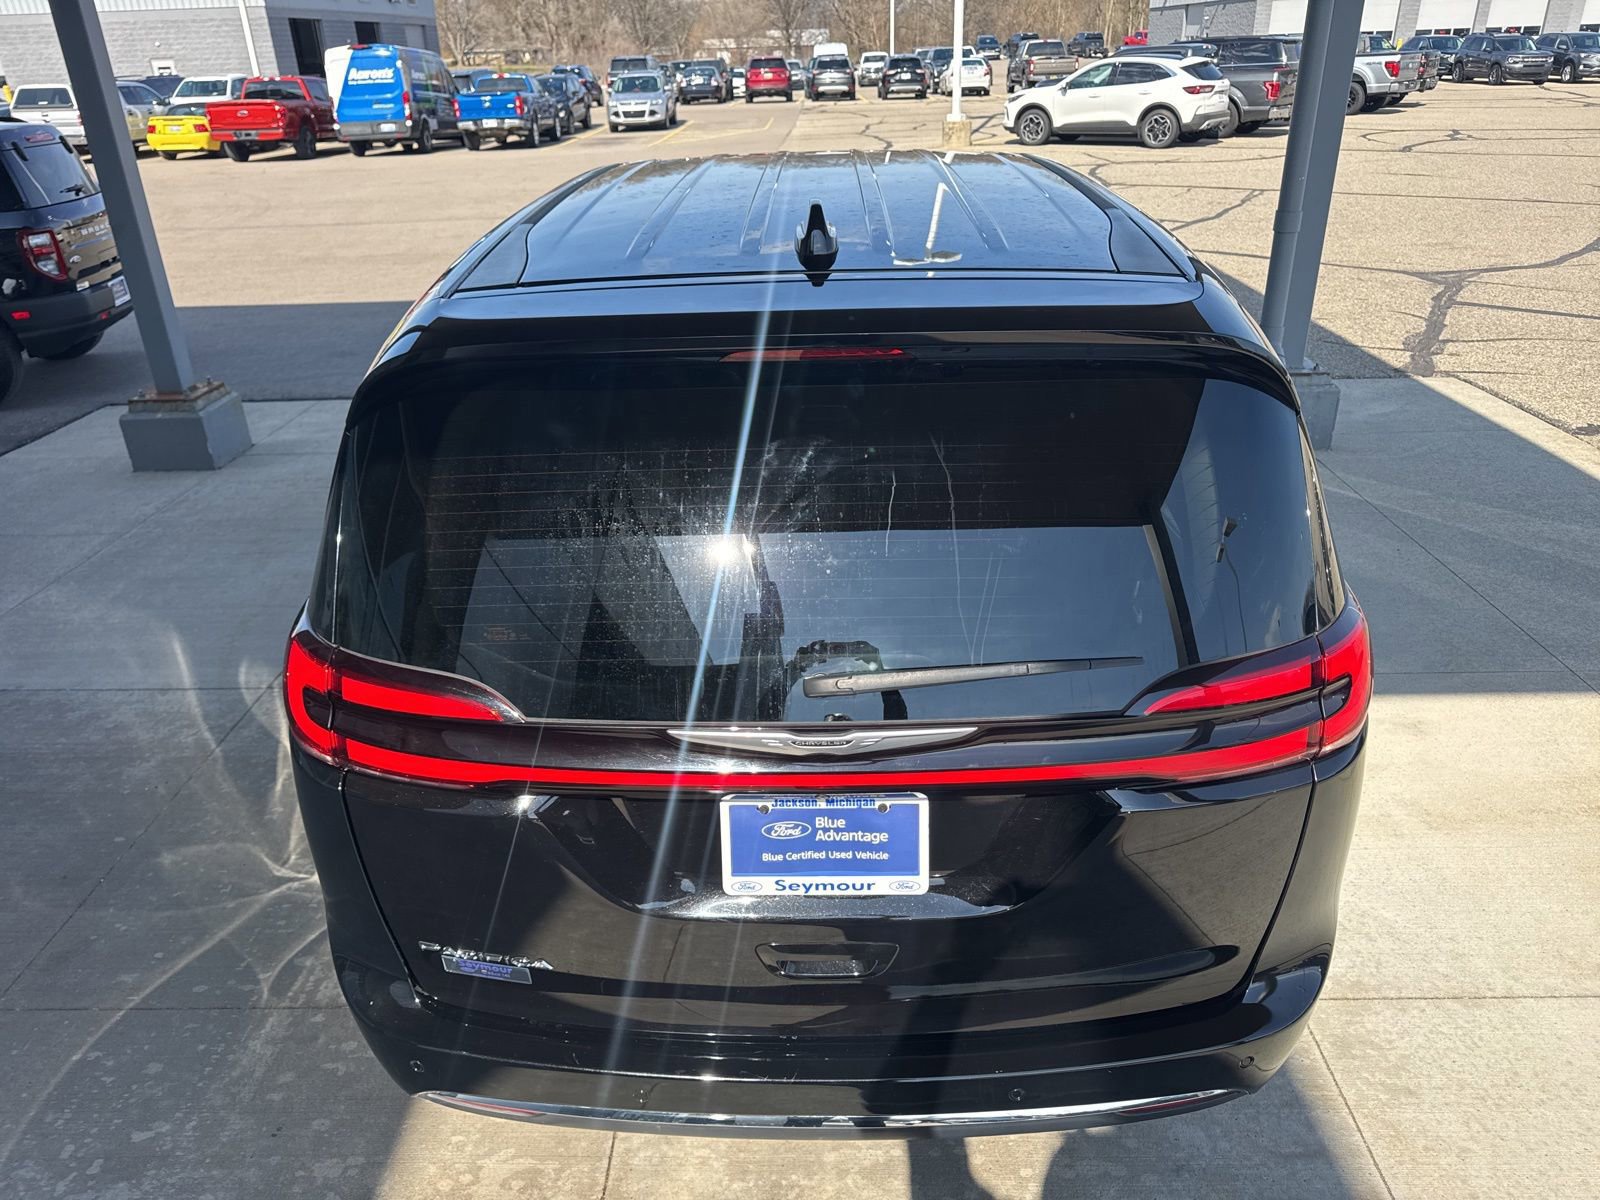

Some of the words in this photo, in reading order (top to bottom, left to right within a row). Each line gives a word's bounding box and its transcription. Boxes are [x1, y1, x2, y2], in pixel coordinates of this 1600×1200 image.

[80, 223, 110, 236] BRONC
[825, 798, 876, 809] Michigan
[815, 816, 846, 829] Blue
[815, 829, 889, 844] Advantage
[761, 852, 784, 862] Blue
[785, 850, 826, 861] Certified
[828, 850, 853, 860] Used
[855, 850, 889, 860] Vehicle
[774, 879, 876, 894] Seymour
[458, 958, 513, 974] Seymour
